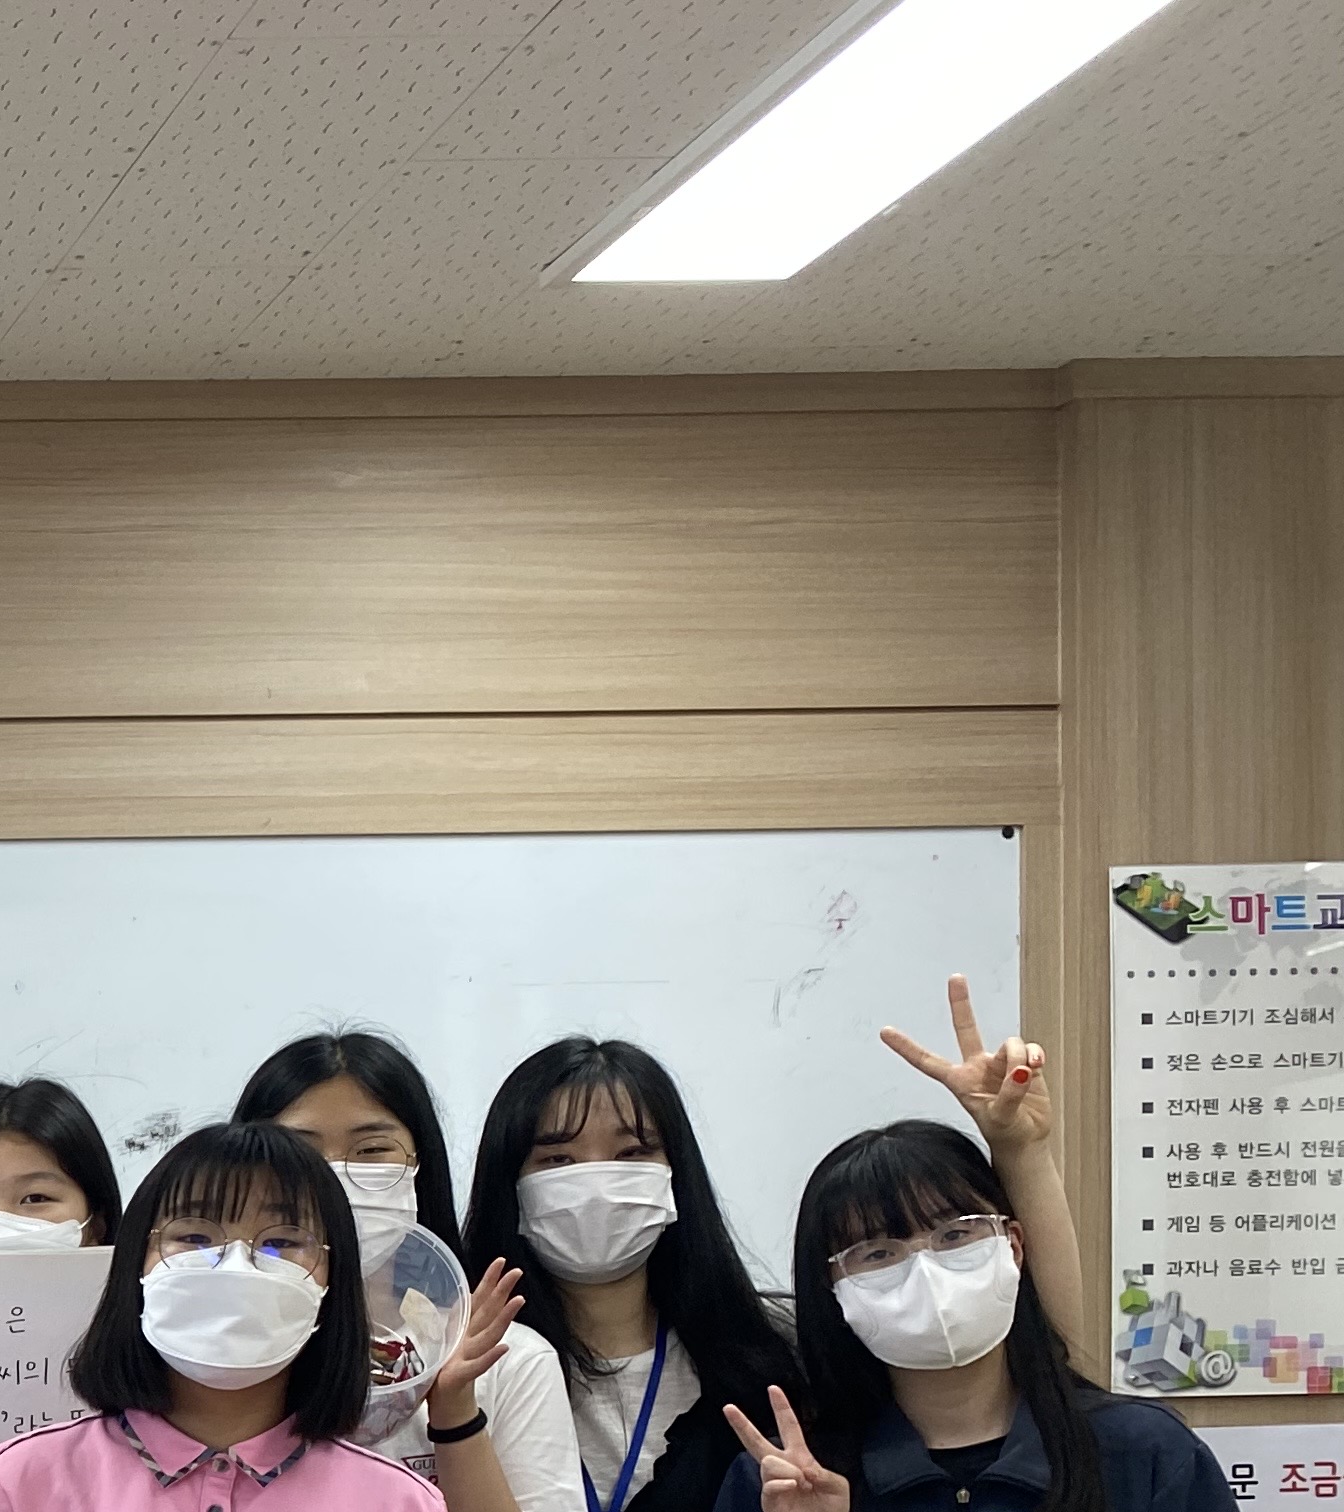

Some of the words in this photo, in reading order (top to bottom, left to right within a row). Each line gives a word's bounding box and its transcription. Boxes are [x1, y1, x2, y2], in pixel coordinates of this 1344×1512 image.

[1166, 1008, 1254, 1026] 스마트기기
[1264, 1007, 1335, 1025] 조심해서
[1167, 1053, 1201, 1071] 젖은
[1211, 1053, 1263, 1070] 손으로
[1167, 1099, 1219, 1116] 전자펜
[1229, 1097, 1263, 1114] 사용
[1274, 1097, 1290, 1113] 후
[1167, 1143, 1201, 1160] 사용
[1211, 1142, 1228, 1159] 후
[1239, 1141, 1290, 1159] 반드시
[1167, 1170, 1237, 1188] 번호대로
[1247, 1169, 1317, 1187] 충전함에
[1167, 1215, 1200, 1233] 게임
[1209, 1216, 1225, 1233] 등
[1235, 1213, 1336, 1232] 어플리케이션
[1167, 1259, 1219, 1276] 과자나
[1229, 1259, 1281, 1276] 음료수
[1292, 1258, 1325, 1275] 반입
